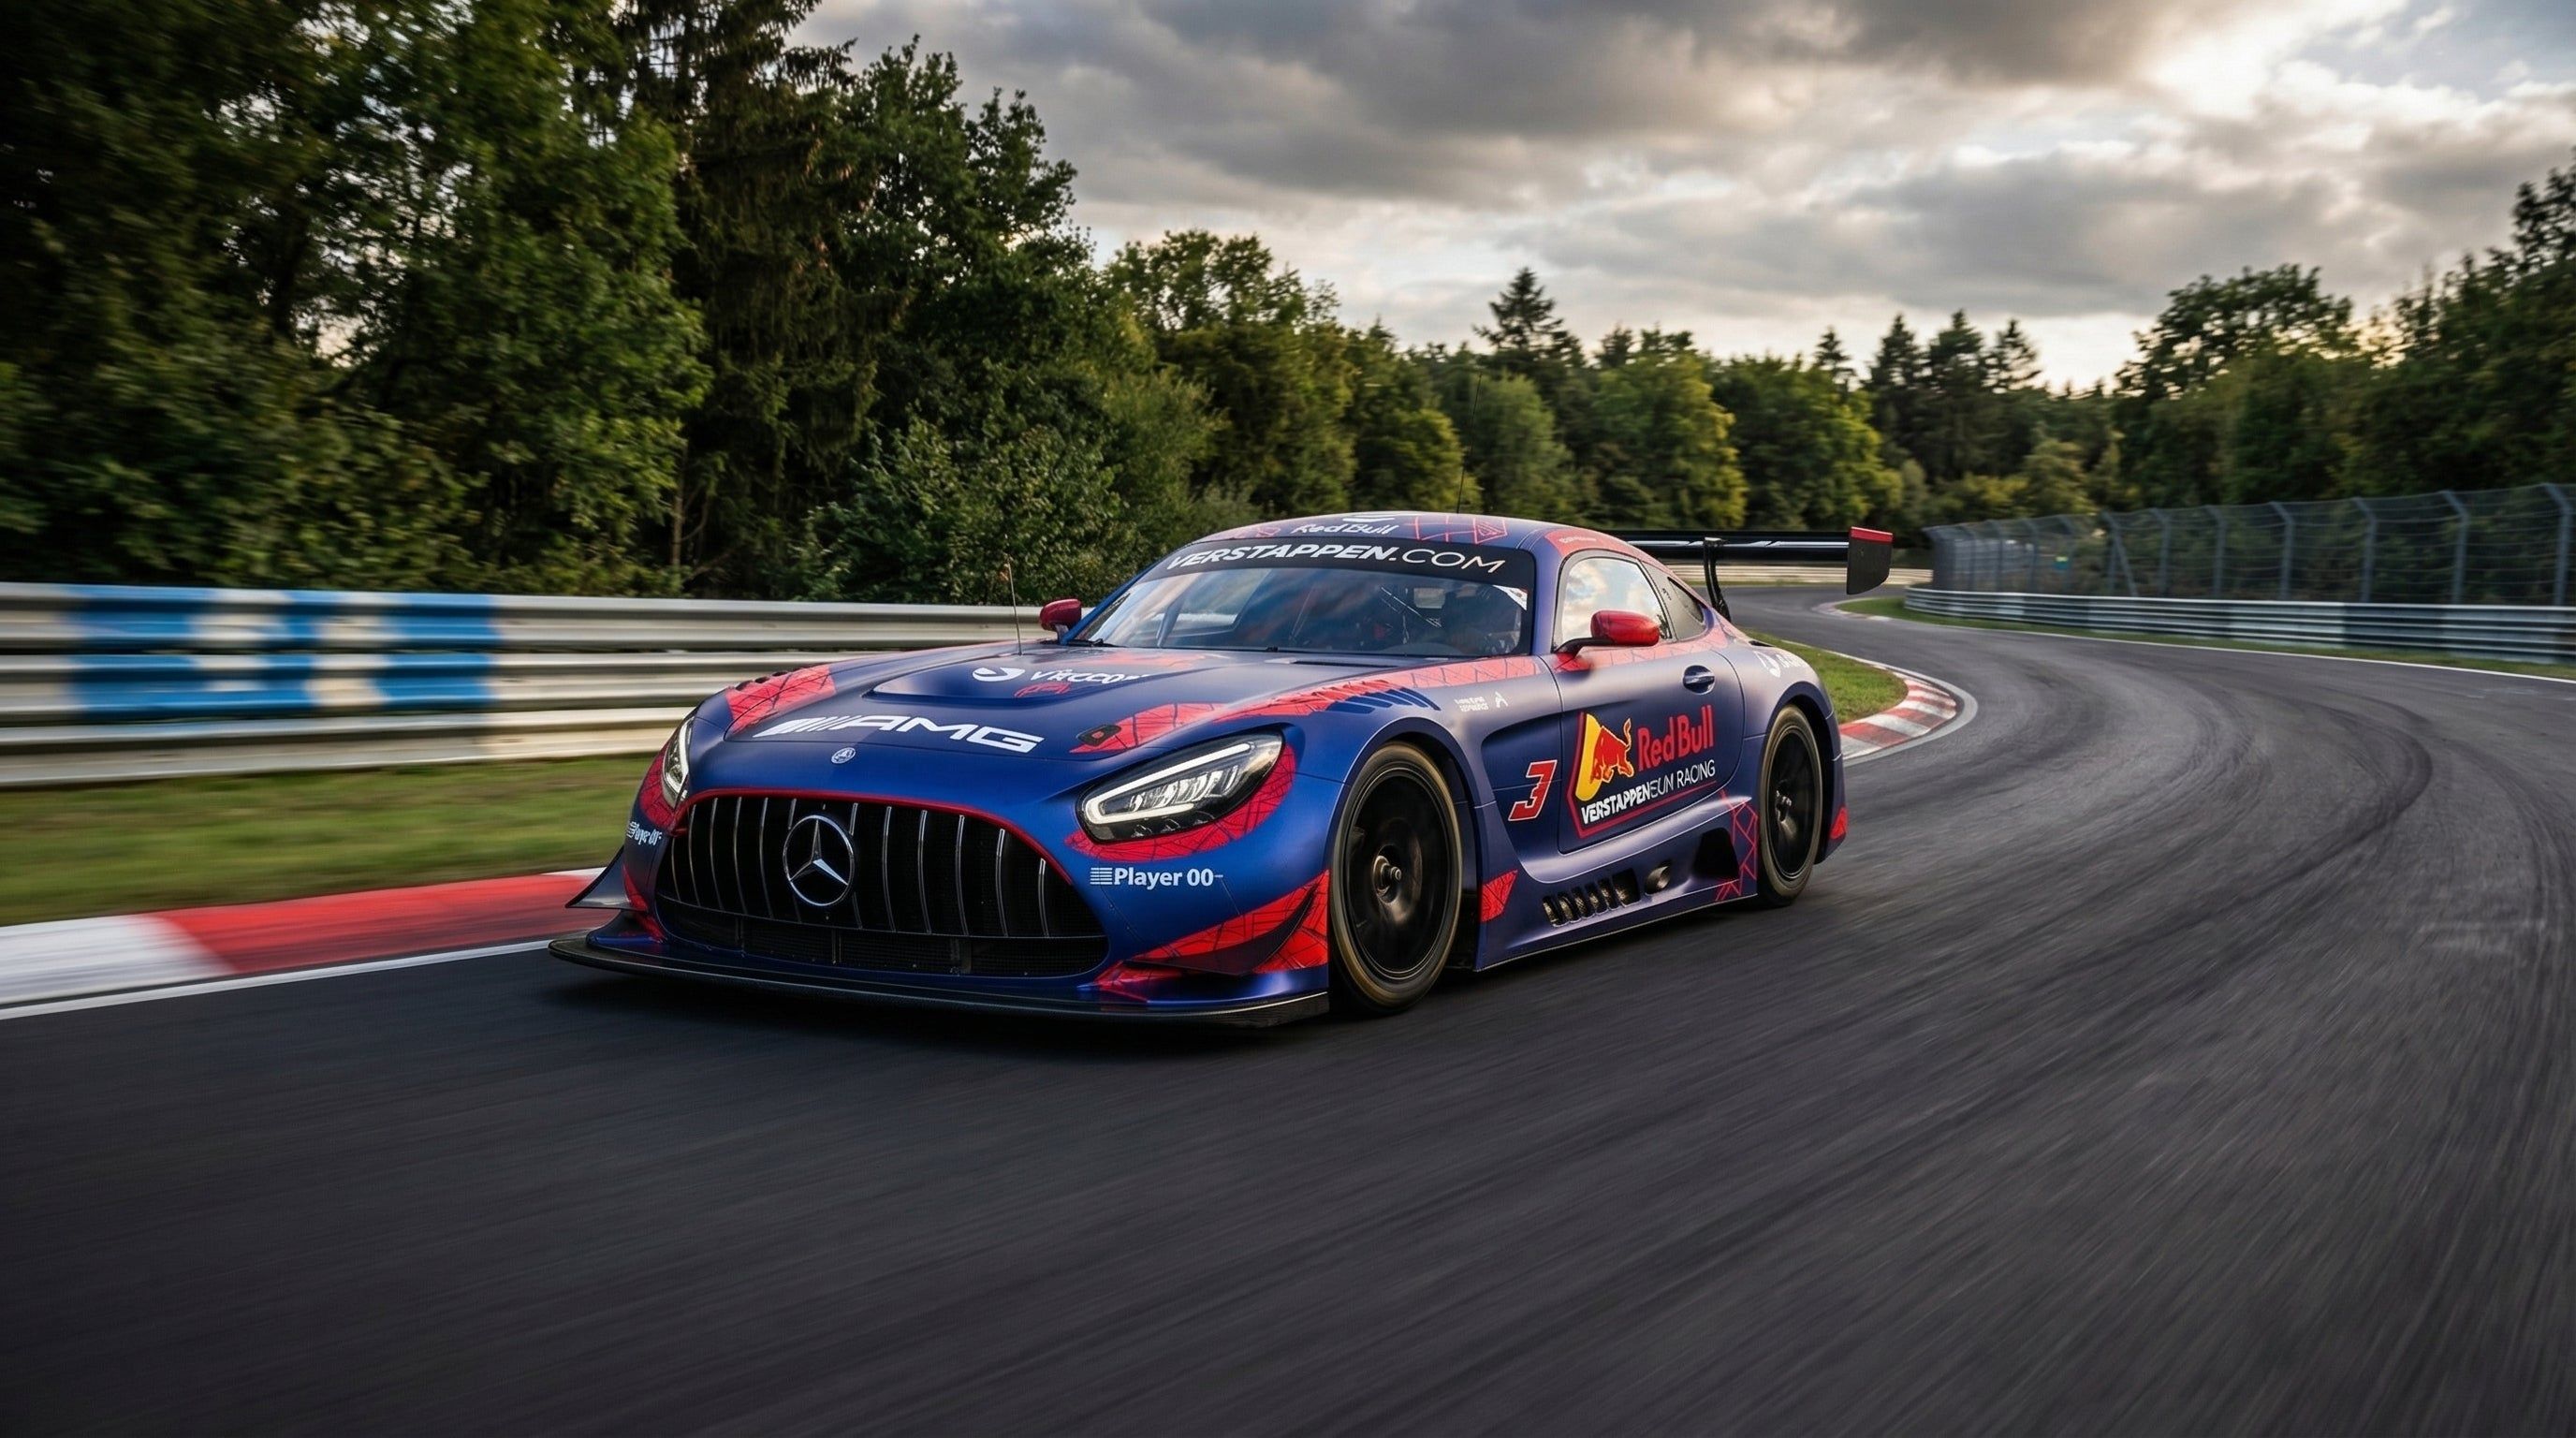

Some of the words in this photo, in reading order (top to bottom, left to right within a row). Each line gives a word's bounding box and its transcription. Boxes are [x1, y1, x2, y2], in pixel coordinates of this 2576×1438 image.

[1291, 523, 1348, 535] Red
[1342, 523, 1399, 535] Bull
[1166, 543, 1505, 574] VERSTAPPEN.COM
[1637, 715, 1676, 771] Red
[1676, 704, 1715, 757] Bull
[1676, 759, 1716, 789] RACING
[1507, 758, 1559, 822] 3
[1114, 867, 1183, 890] Player
